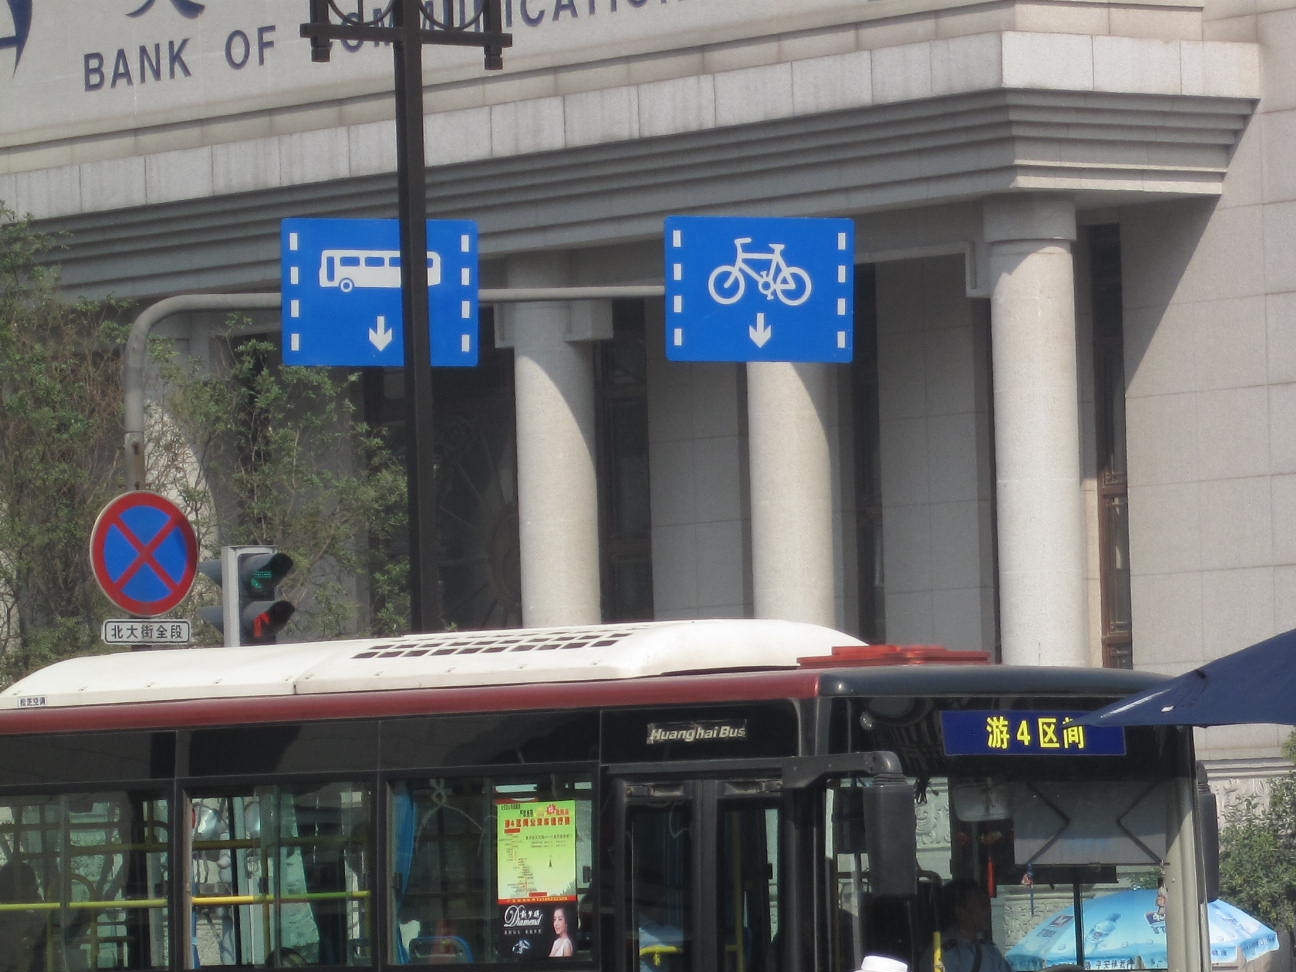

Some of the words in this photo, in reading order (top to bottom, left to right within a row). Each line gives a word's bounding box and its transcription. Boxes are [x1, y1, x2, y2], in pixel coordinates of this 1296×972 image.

[84, 38, 192, 92] BANK
[225, 25, 276, 70] OF
[111, 624, 182, 639] 北大街全段
[651, 726, 718, 742] Huanghai
[719, 725, 746, 738] Bus
[986, 716, 1084, 749] 游4区间
